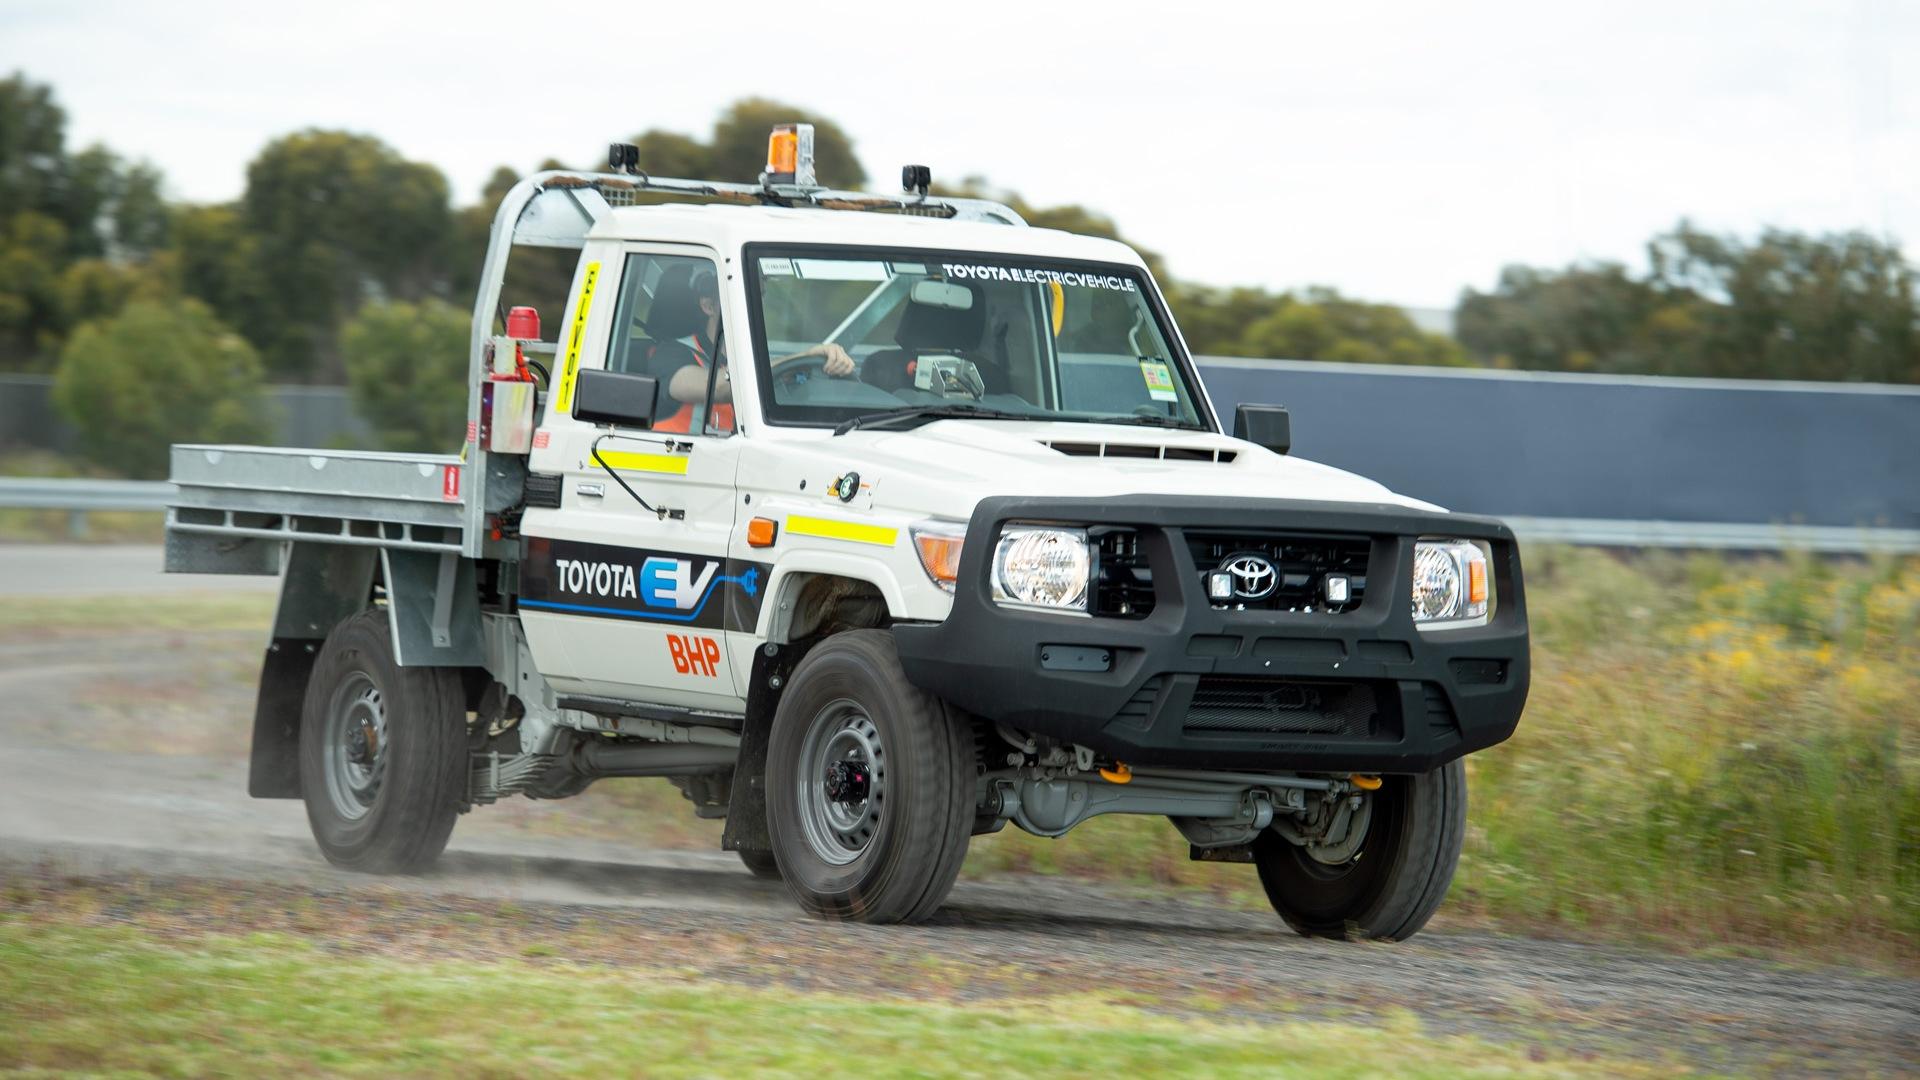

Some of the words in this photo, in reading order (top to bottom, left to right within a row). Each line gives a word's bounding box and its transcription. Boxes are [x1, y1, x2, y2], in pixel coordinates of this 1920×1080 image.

[556, 559, 637, 599] TOYOTA
[640, 556, 720, 610] EV
[666, 632, 721, 678] BHP
